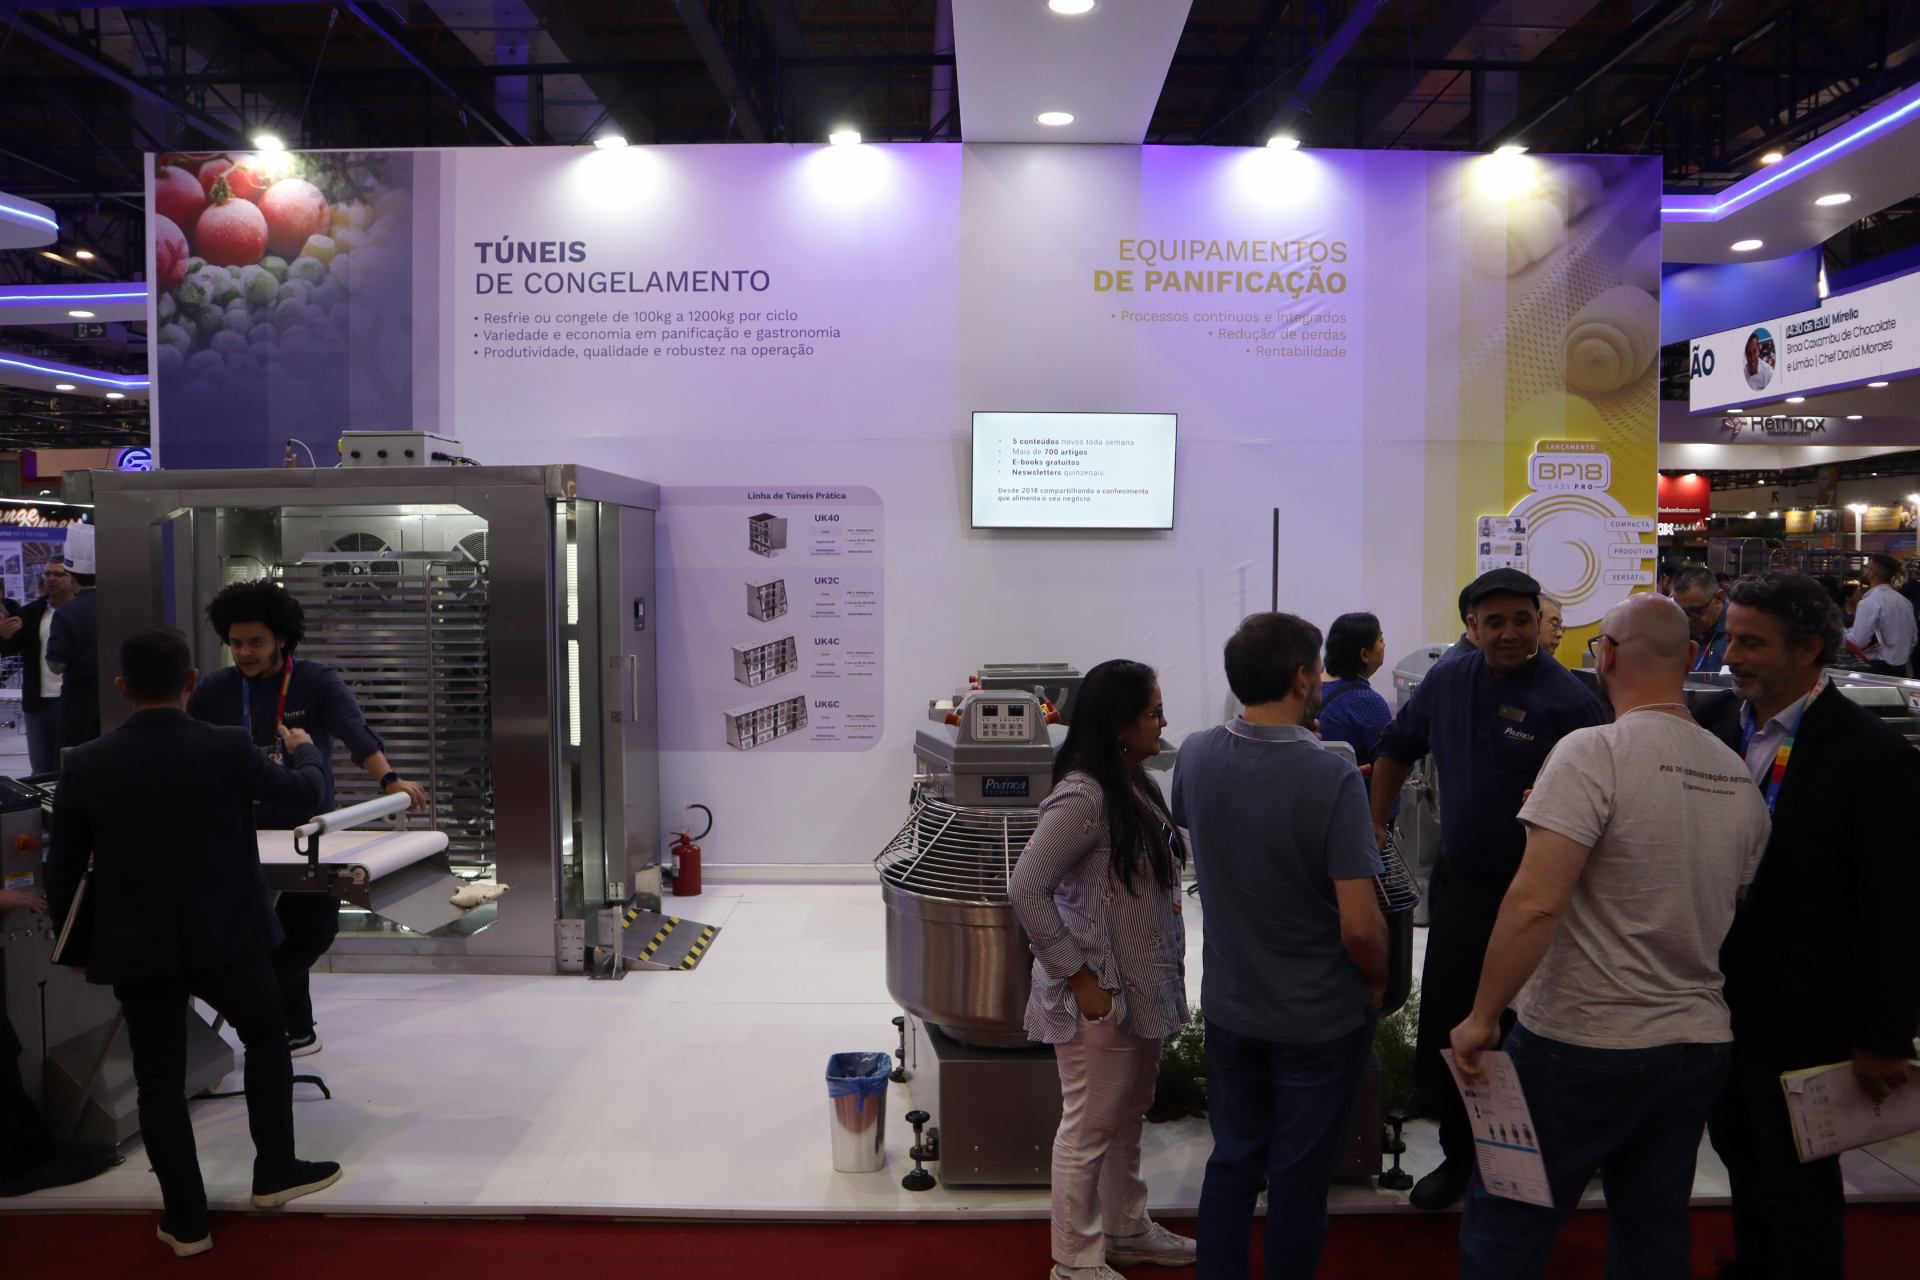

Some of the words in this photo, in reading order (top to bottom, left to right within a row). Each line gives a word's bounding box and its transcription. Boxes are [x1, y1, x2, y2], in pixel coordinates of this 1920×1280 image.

[474, 235, 587, 264] TÚNEIS
[1118, 239, 1348, 267] EQUIPAMENTOS
[475, 273, 514, 294] DE
[524, 270, 771, 294] CONGELAMENTO
[1093, 270, 1134, 292] DE
[1144, 265, 1347, 299] PANIFICAÇÃO
[484, 311, 530, 324] Resfrie
[534, 313, 551, 324] ou
[555, 311, 608, 327] congele
[612, 311, 629, 323] de
[634, 311, 672, 326] 100kg
[676, 313, 685, 323] a
[688, 310, 735, 325] 1200kg
[739, 312, 762, 325] por
[766, 309, 798, 322] ciclo
[1121, 310, 1189, 322] Processos
[1194, 310, 1260, 323] contínuos
[1265, 313, 1272, 322] e
[1277, 311, 1347, 326] integrados
[483, 327, 549, 341] Variedade
[553, 330, 561, 341] e
[566, 327, 631, 340] economia
[636, 329, 657, 340] em
[661, 325, 739, 342] panificação
[744, 328, 752, 339] e
[756, 325, 841, 342] gastronomia
[1218, 328, 1276, 342] Redução
[1280, 328, 1297, 341] de
[1301, 329, 1346, 343] perdas
[1804, 331, 1840, 353] Caxambu
[1841, 328, 1852, 342] de
[1853, 318, 1897, 339] Chocolate
[484, 345, 579, 359] Produtividade,
[583, 344, 649, 359] qualidade
[654, 346, 662, 356] e
[666, 343, 726, 357] robustez
[731, 345, 746, 356] na
[751, 344, 814, 359] operação
[1256, 345, 1347, 357] Rentabilidade
[1818, 350, 1836, 365] Chef
[1838, 344, 1861, 361] David
[1861, 340, 1893, 357] Moraes
[1019, 437, 1060, 445] conteúdos
[1044, 448, 1059, 456] 700
[1060, 448, 1088, 457] artigos
[1012, 458, 1044, 466] E-books
[1045, 458, 1080, 467] gratuitos
[1538, 463, 1603, 481] BP18
[747, 492, 772, 500] Linha
[773, 492, 784, 500] de
[786, 491, 814, 500] Túneis
[815, 491, 847, 500] Prática
[1102, 487, 1149, 495] conhecimento
[814, 514, 840, 523] UK40
[1610, 520, 1651, 529] COMPACTA
[1613, 547, 1654, 556] PRODUTIVA
[814, 577, 840, 585] UK2C
[1612, 571, 1646, 582] VERSÁTIL
[814, 637, 841, 646] UK4C
[814, 700, 841, 709] UK6C
